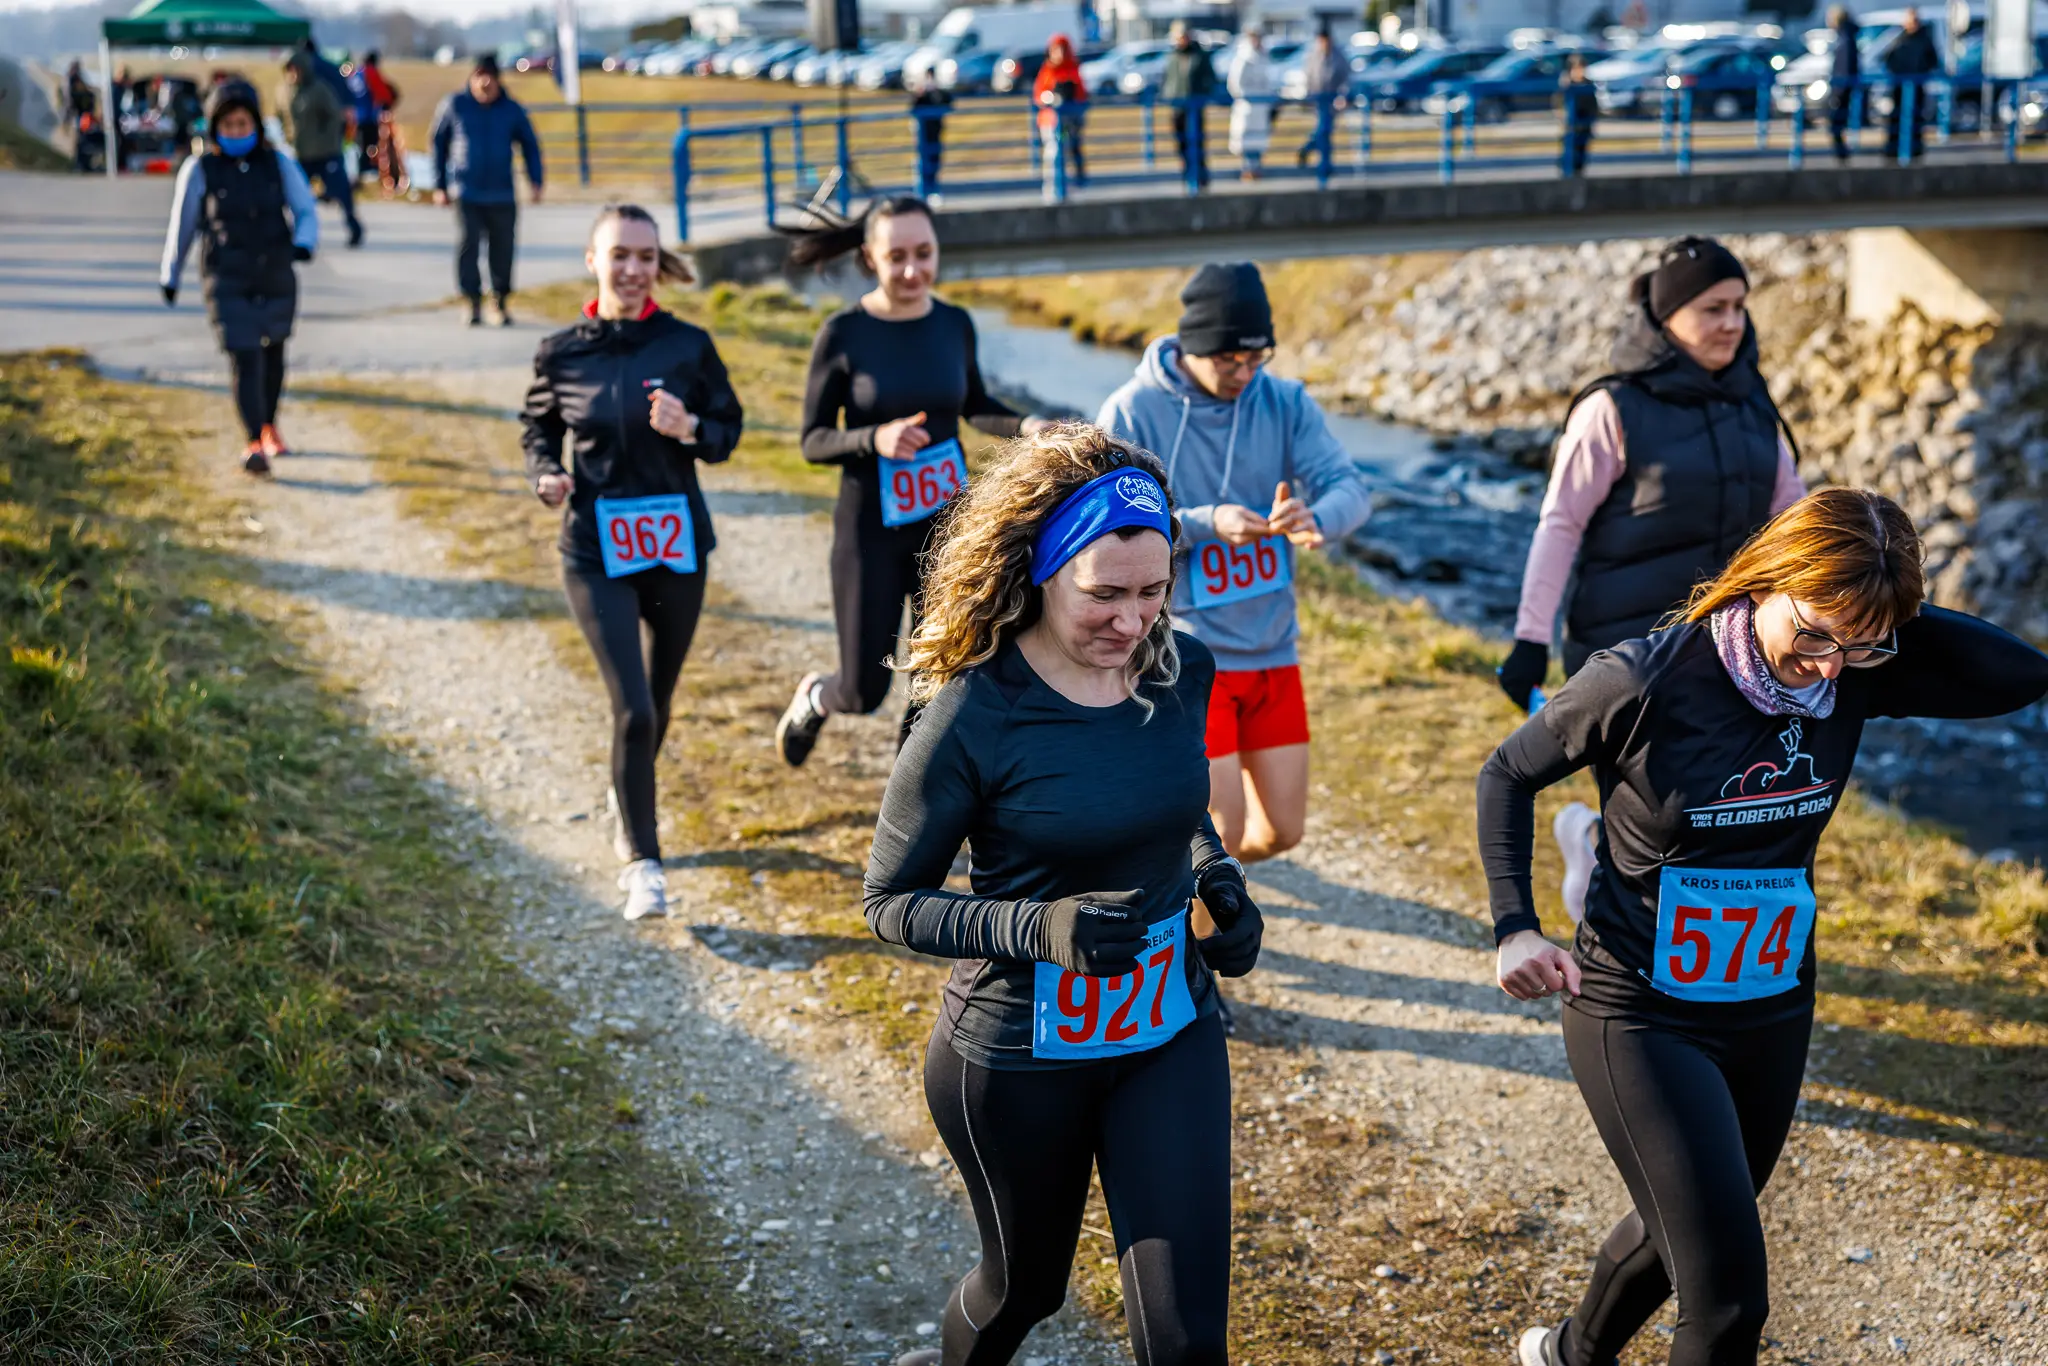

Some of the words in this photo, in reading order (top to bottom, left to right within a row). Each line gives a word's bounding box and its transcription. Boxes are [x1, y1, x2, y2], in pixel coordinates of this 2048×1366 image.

[892, 459, 961, 513] 963
[609, 514, 684, 561] 962
[1201, 535, 1278, 595] 956
[1690, 813, 1713, 821] KROS
[1692, 820, 1712, 828] LIGA
[1715, 805, 1795, 827] GLOBETKA
[1797, 794, 1833, 816] 2024
[1680, 876, 1720, 890] KROS
[1723, 879, 1753, 891] LIGA
[1755, 877, 1796, 890] PRELOG
[1146, 925, 1175, 949] RELOG
[1669, 905, 1797, 984] 574
[1057, 944, 1175, 1044] 927
